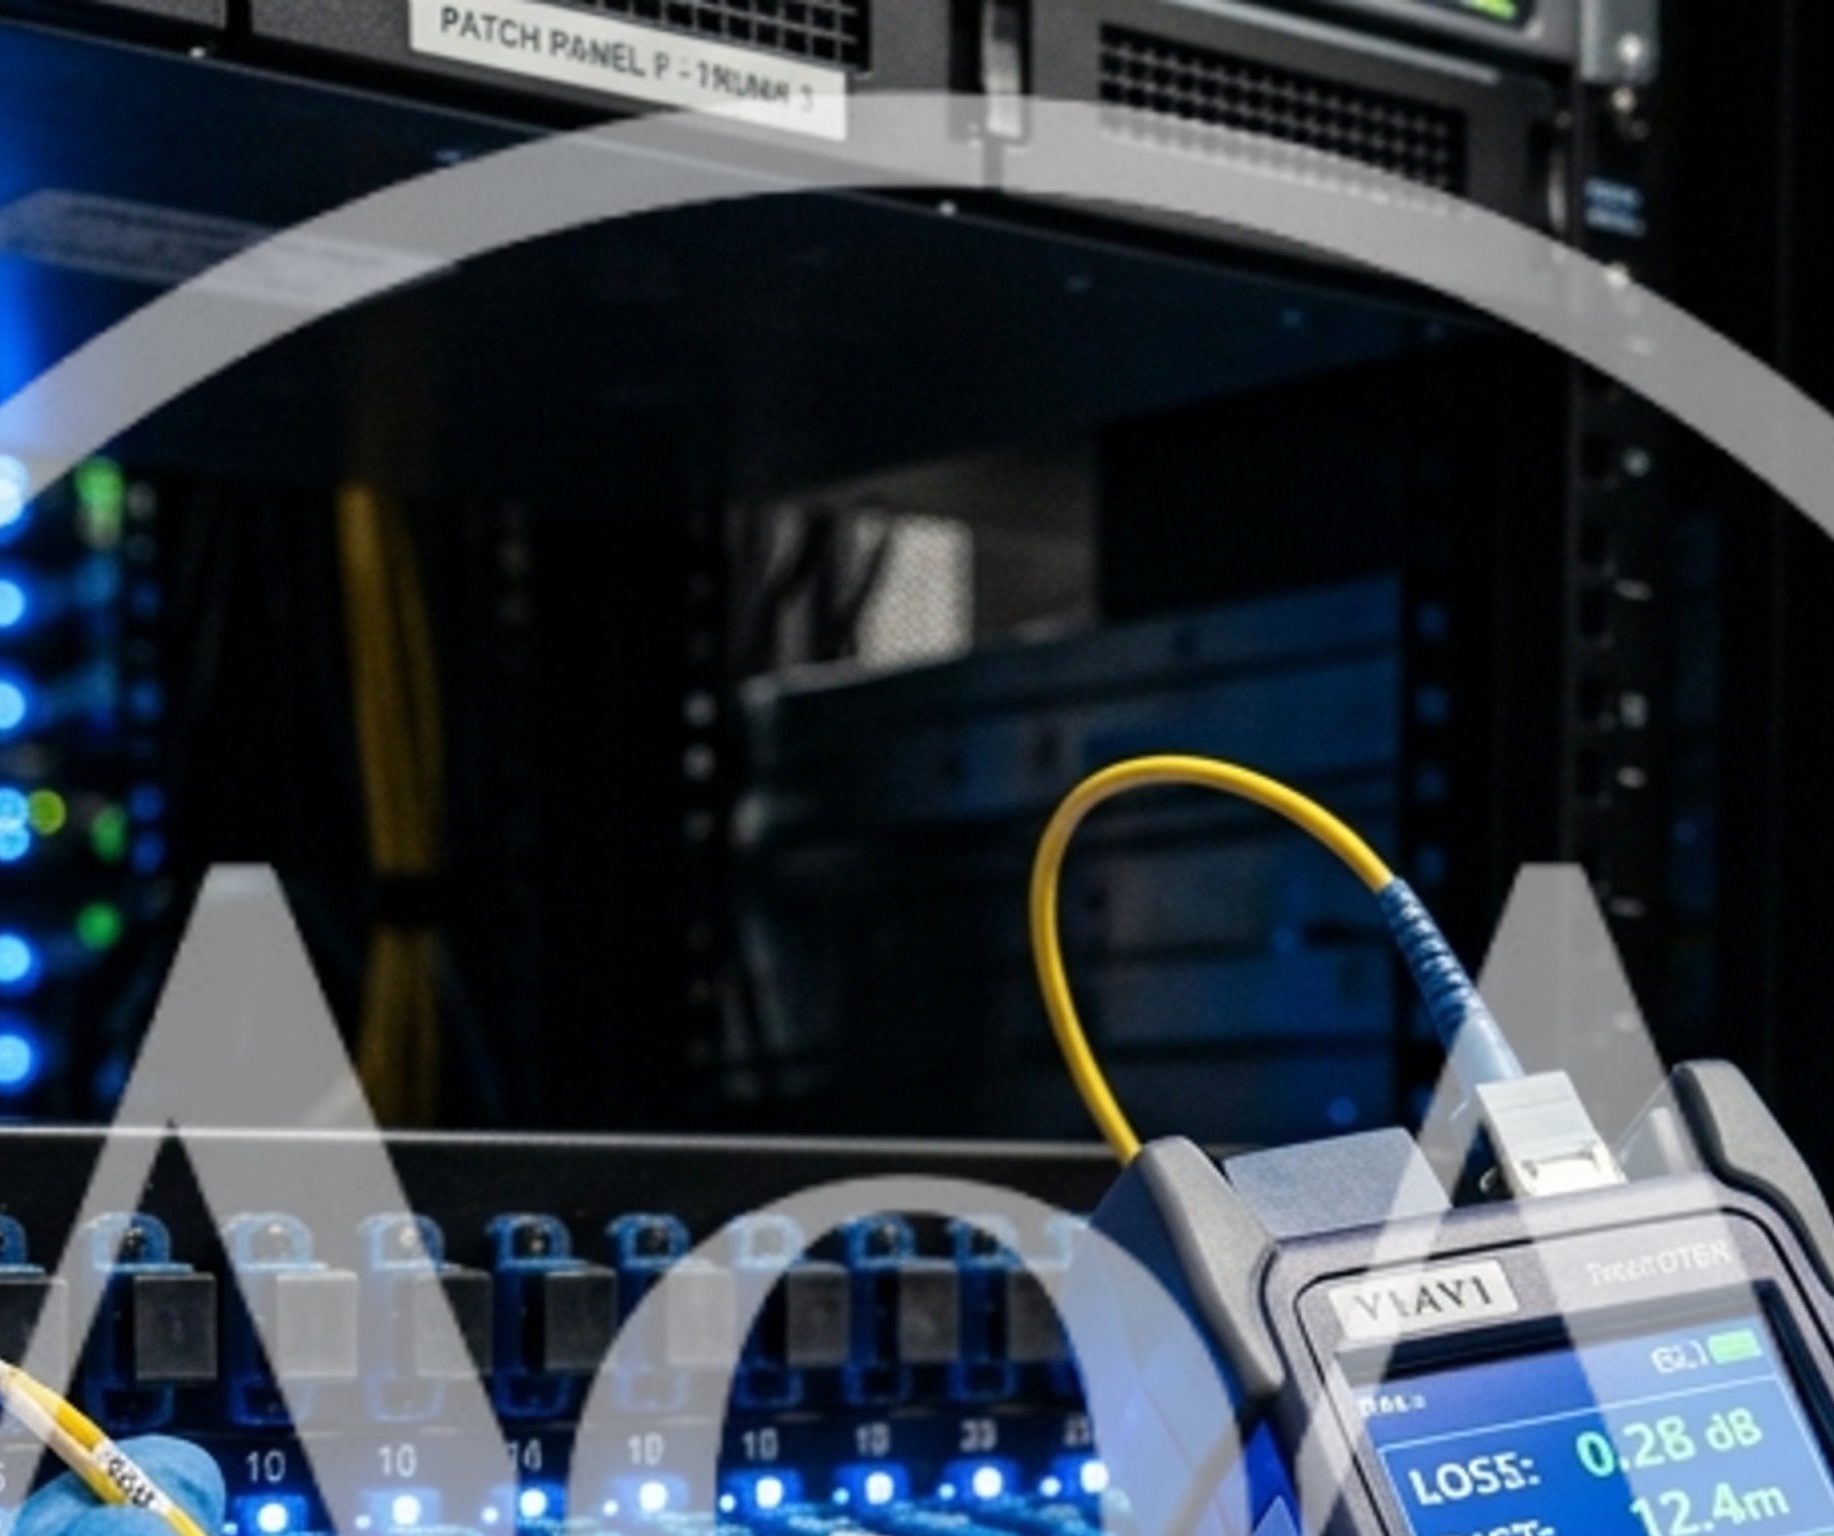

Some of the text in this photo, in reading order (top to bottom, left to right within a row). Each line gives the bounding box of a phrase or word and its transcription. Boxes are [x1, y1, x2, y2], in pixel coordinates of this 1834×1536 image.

[439, 7, 540, 53] PATCH
[549, 29, 646, 77] PANEL
[245, 1449, 287, 1483] 10
[377, 1443, 418, 1478] 10
[1575, 1414, 1696, 1478] 0.28
[1705, 1406, 1763, 1452] dB
